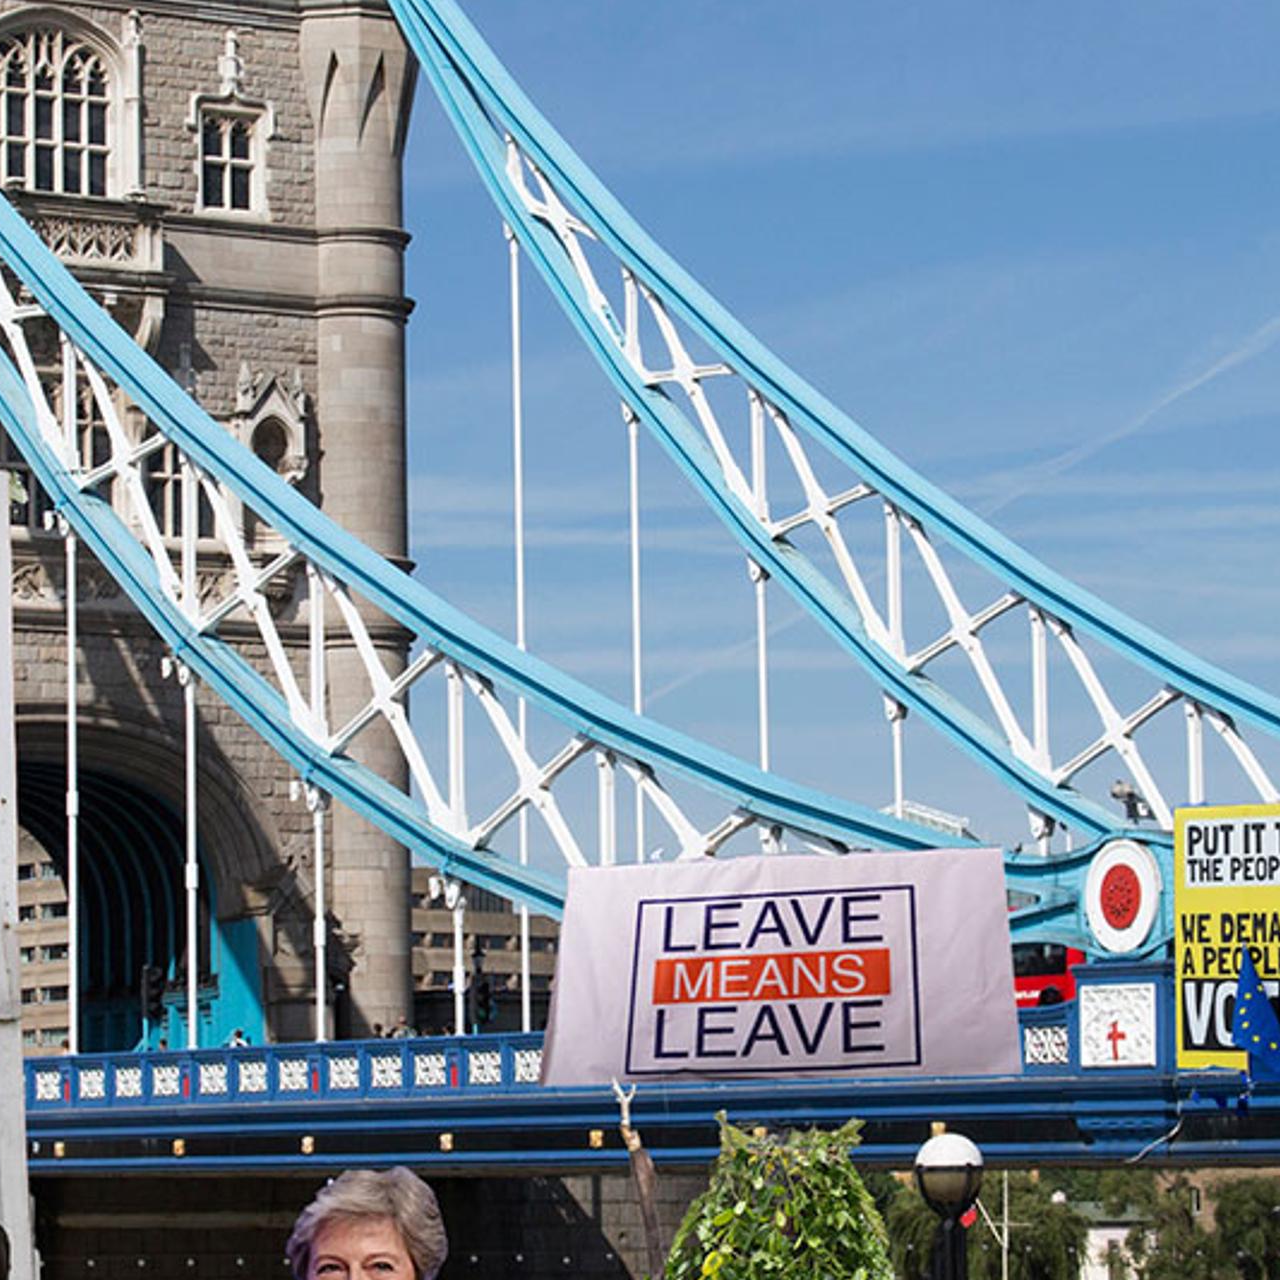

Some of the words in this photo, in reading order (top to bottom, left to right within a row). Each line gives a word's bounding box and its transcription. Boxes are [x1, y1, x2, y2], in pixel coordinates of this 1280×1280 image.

[1188, 824, 1234, 856] PUT
[1243, 823, 1266, 854] IT
[1187, 858, 1223, 882] THE
[662, 894, 883, 952] LEAVE
[1181, 914, 1212, 943] WE
[672, 955, 866, 999] MEANS
[1182, 946, 1196, 975] A
[653, 1000, 885, 1059] LEAVE
